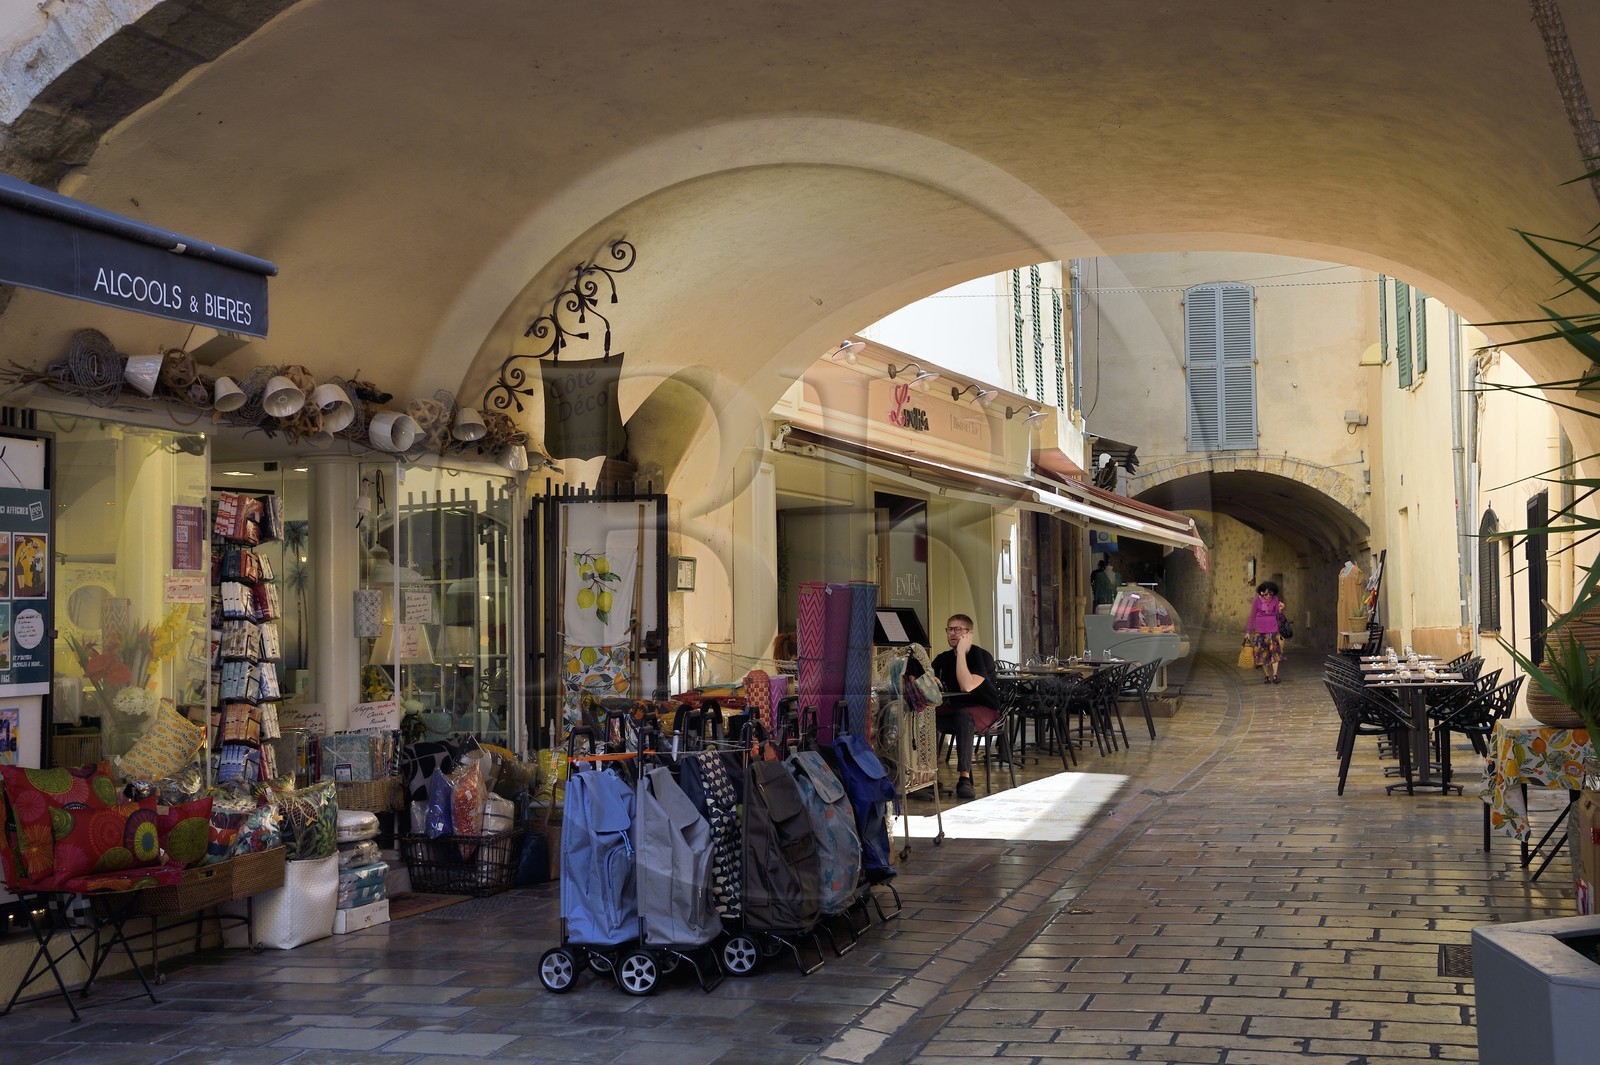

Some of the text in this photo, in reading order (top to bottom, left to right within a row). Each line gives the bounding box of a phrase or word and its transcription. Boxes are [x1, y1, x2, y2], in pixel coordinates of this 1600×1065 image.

[94, 267, 252, 326] ALCOOLS & BIERES
[550, 363, 597, 399] Côté
[558, 391, 608, 423] Déco
